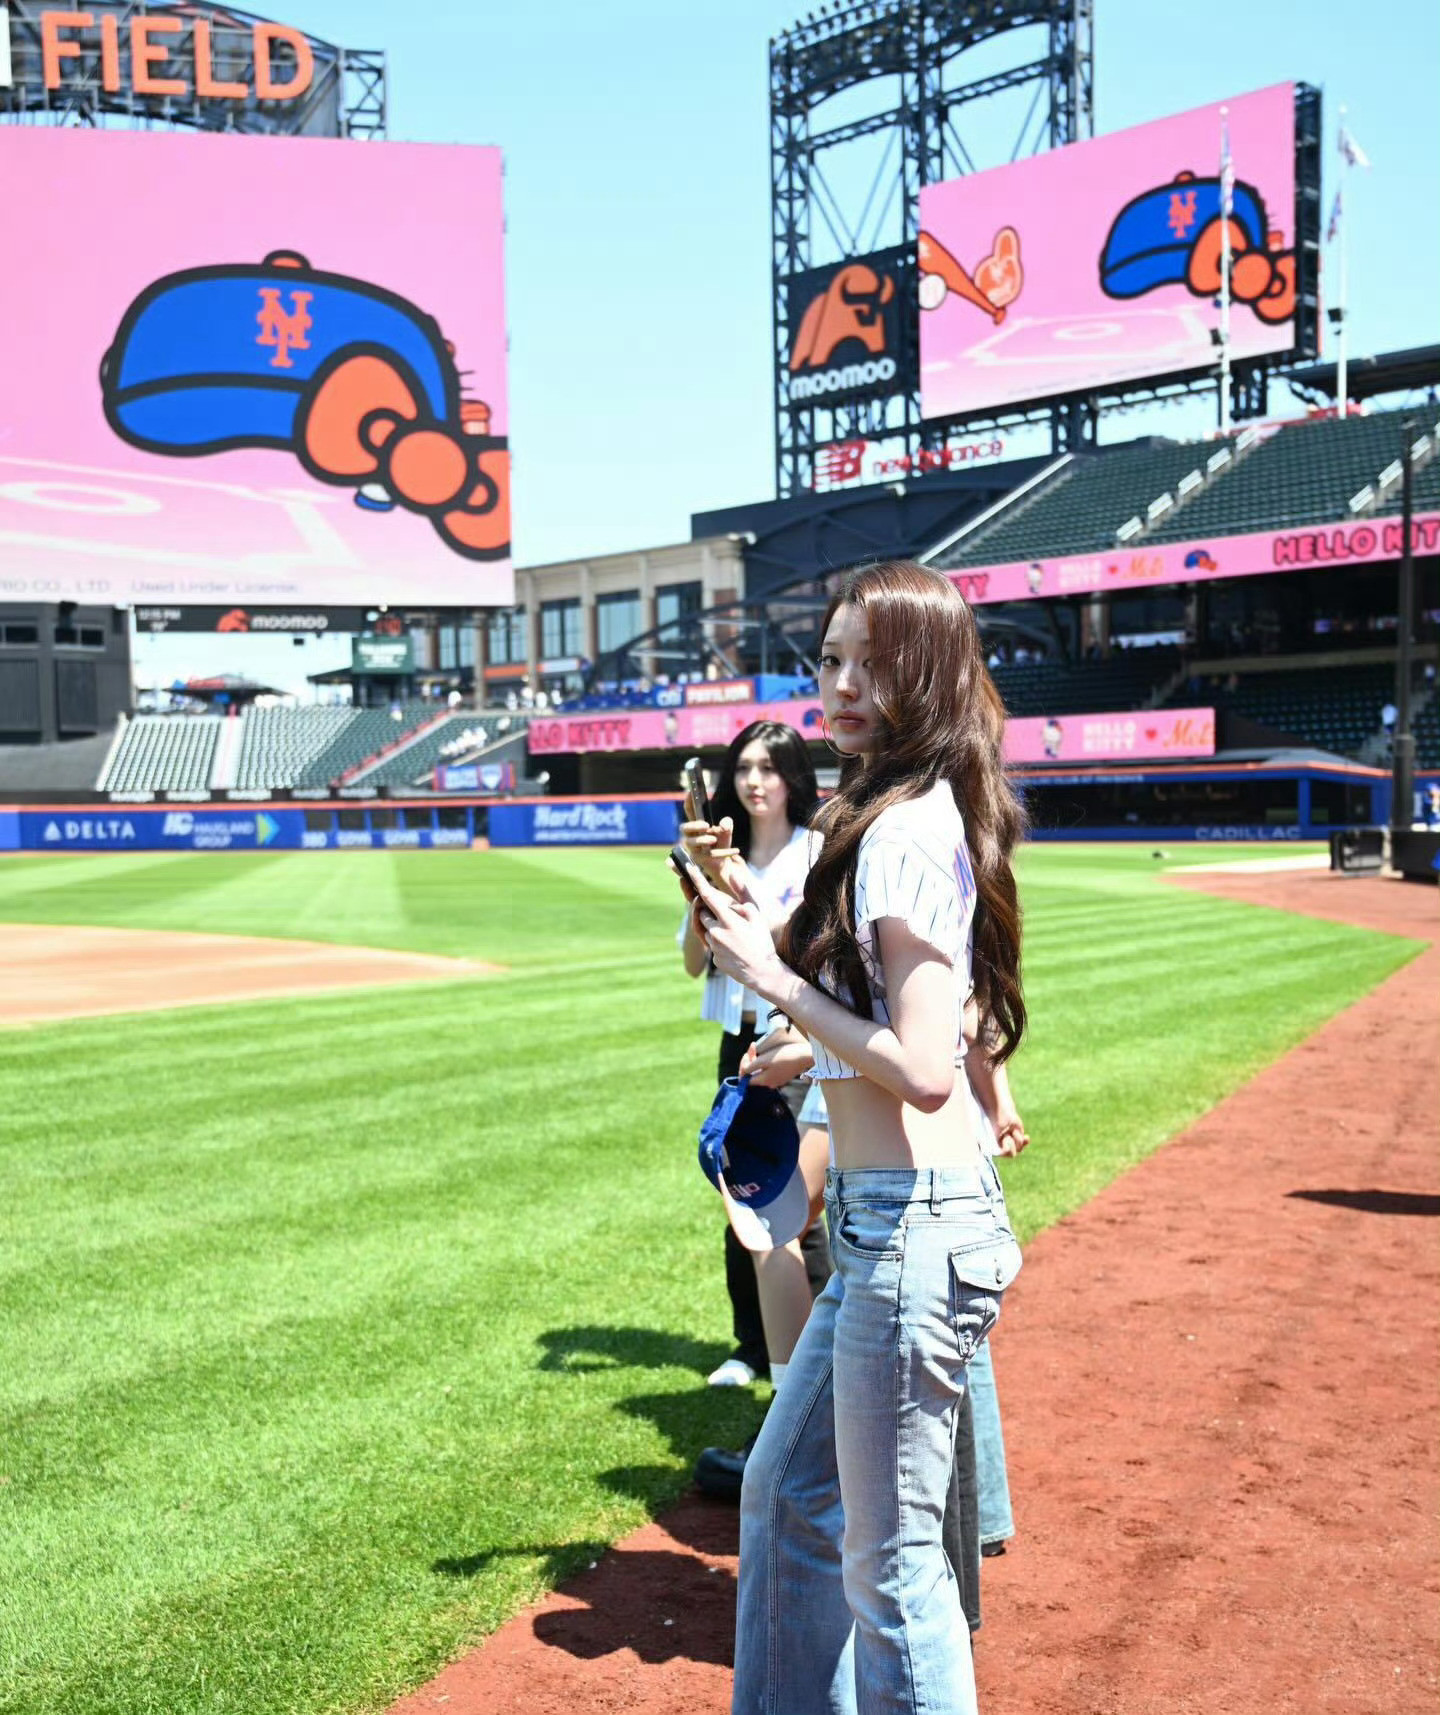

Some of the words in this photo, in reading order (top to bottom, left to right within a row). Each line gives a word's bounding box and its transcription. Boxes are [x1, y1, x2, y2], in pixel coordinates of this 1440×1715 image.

[41, 11, 314, 99] FIELD
[789, 358, 897, 400] moomoo
[1273, 526, 1377, 566] HELLO
[252, 615, 328, 630] moomoo
[567, 719, 631, 746] KITTY
[65, 821, 136, 840] DELTA
[534, 803, 580, 828] Hard
[581, 802, 628, 831] Rock
[1195, 825, 1299, 841] CADILLAC
